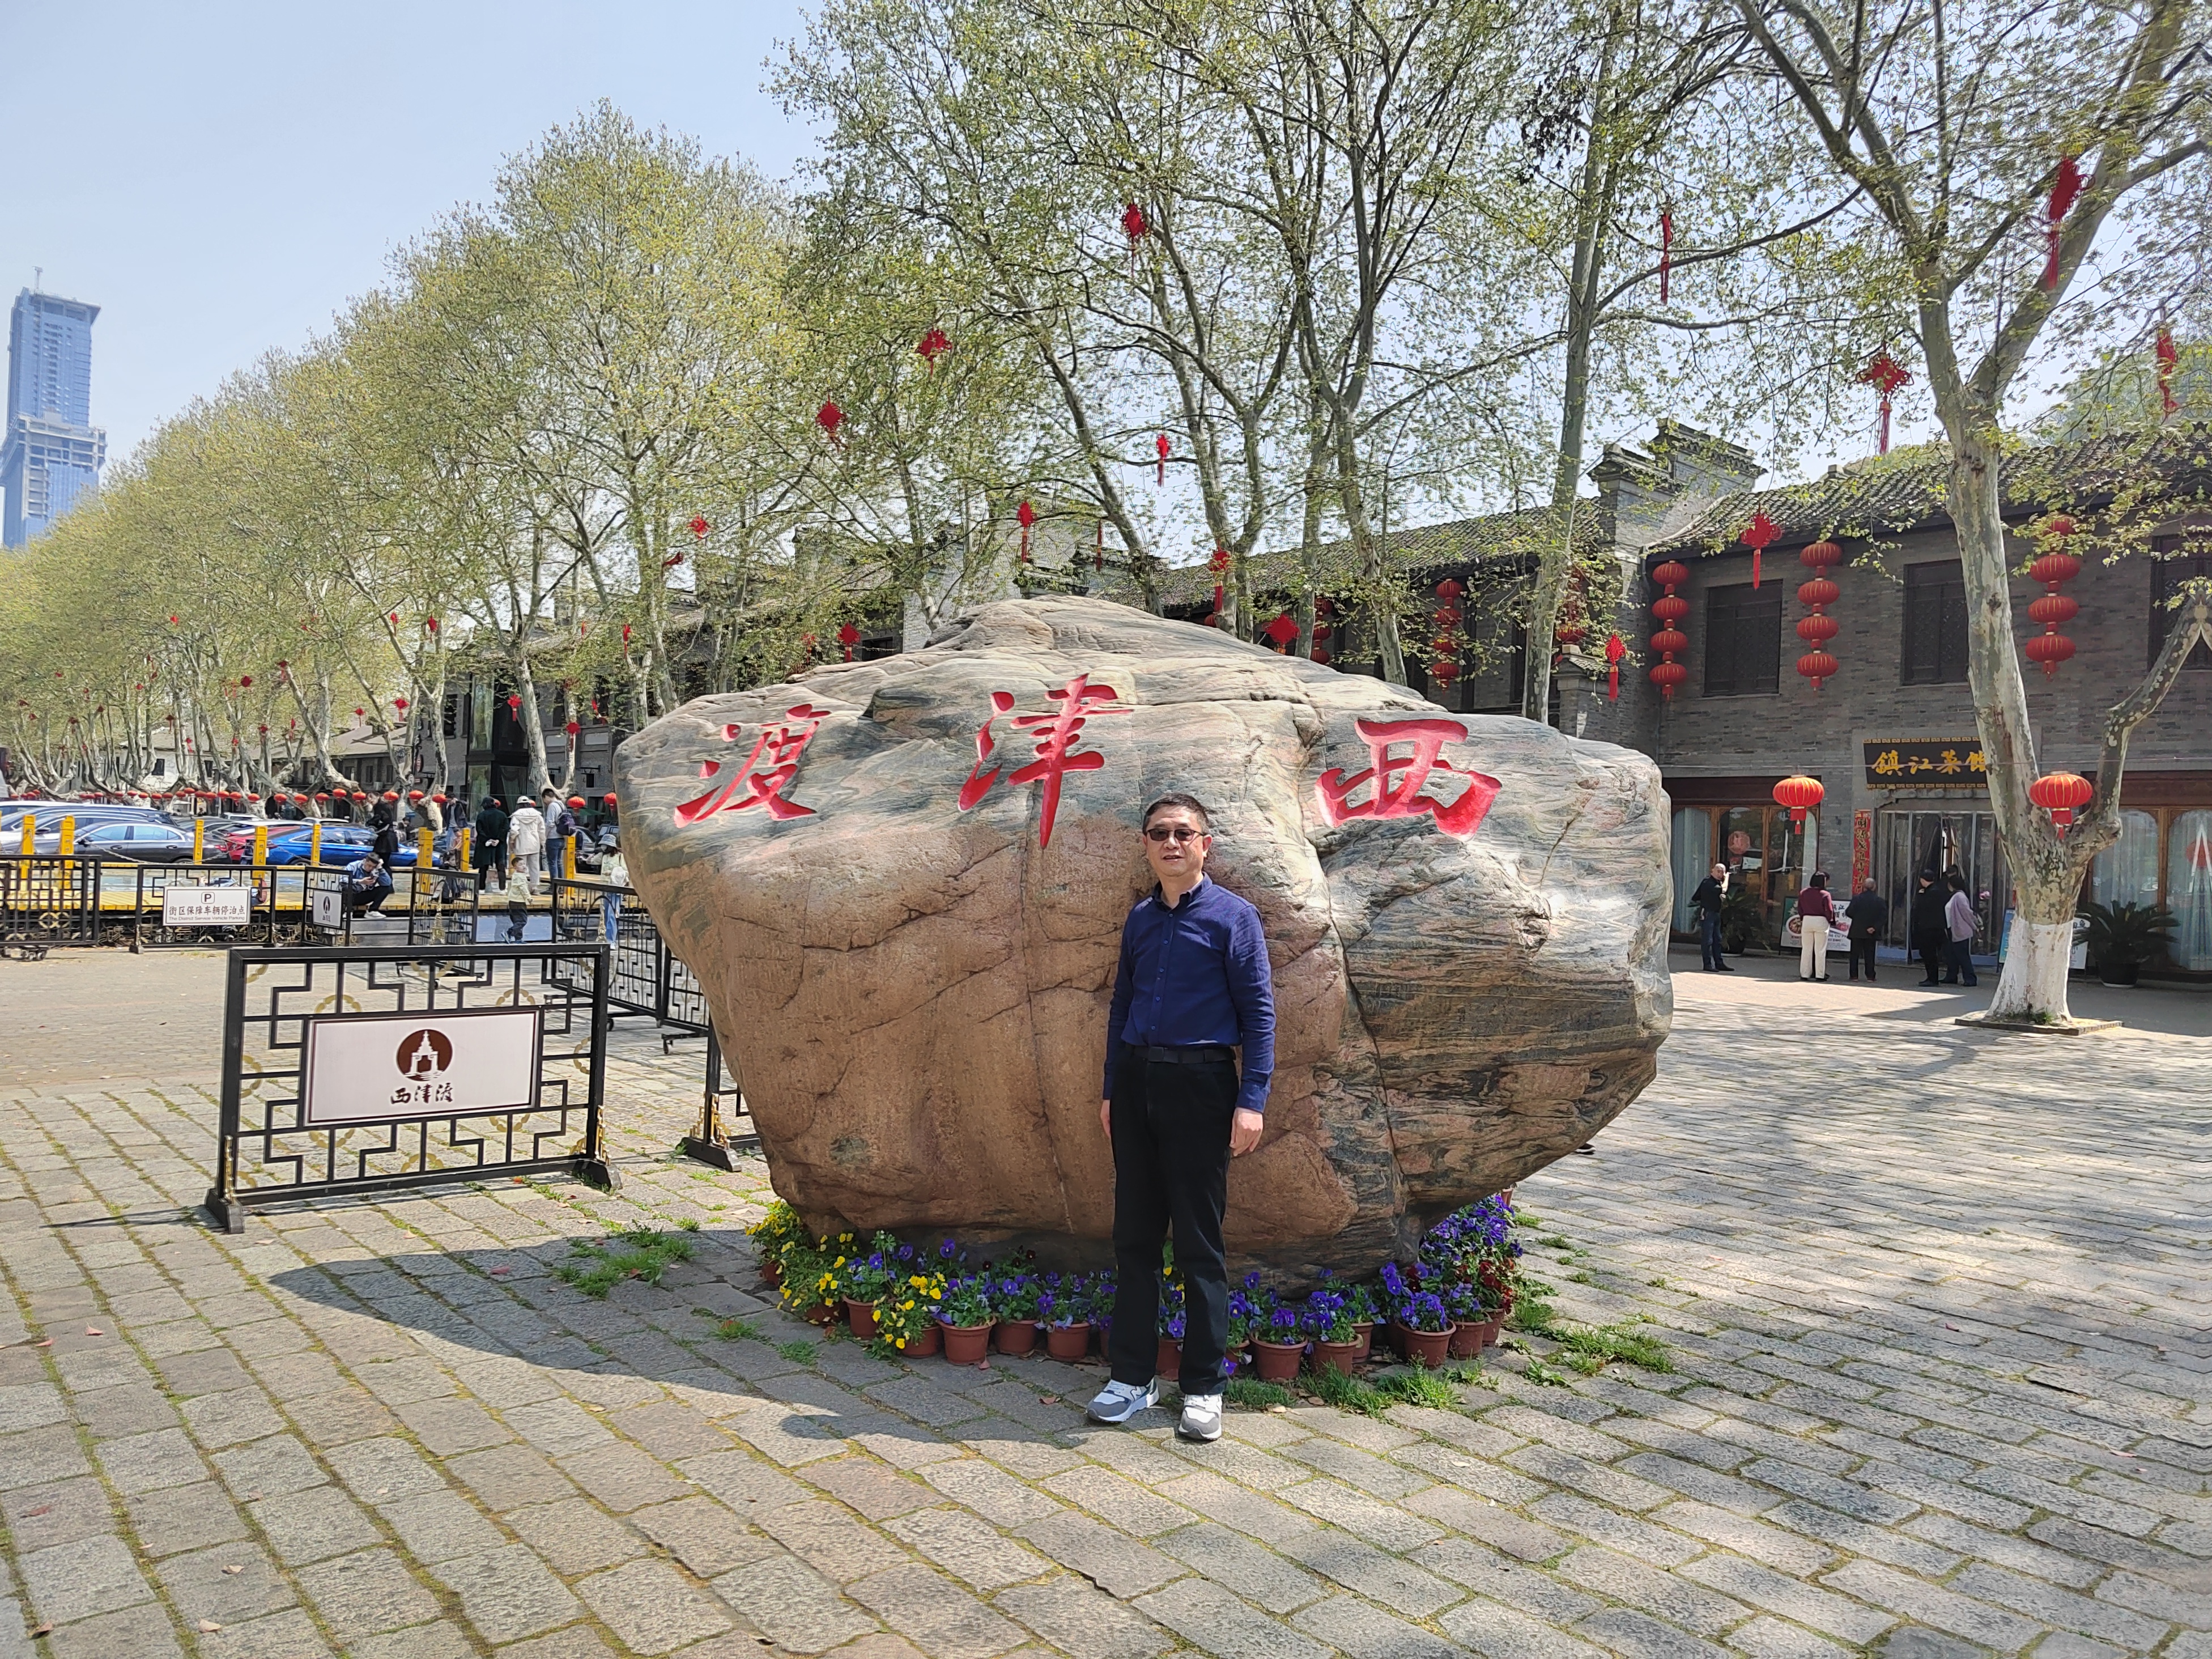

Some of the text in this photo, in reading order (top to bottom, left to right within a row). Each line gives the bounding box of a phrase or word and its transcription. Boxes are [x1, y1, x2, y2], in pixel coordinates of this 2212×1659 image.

[204, 894, 212, 902] P
[169, 905, 245, 916] 街区保障车辆停泊点
[390, 1082, 453, 1104] 西津渡
